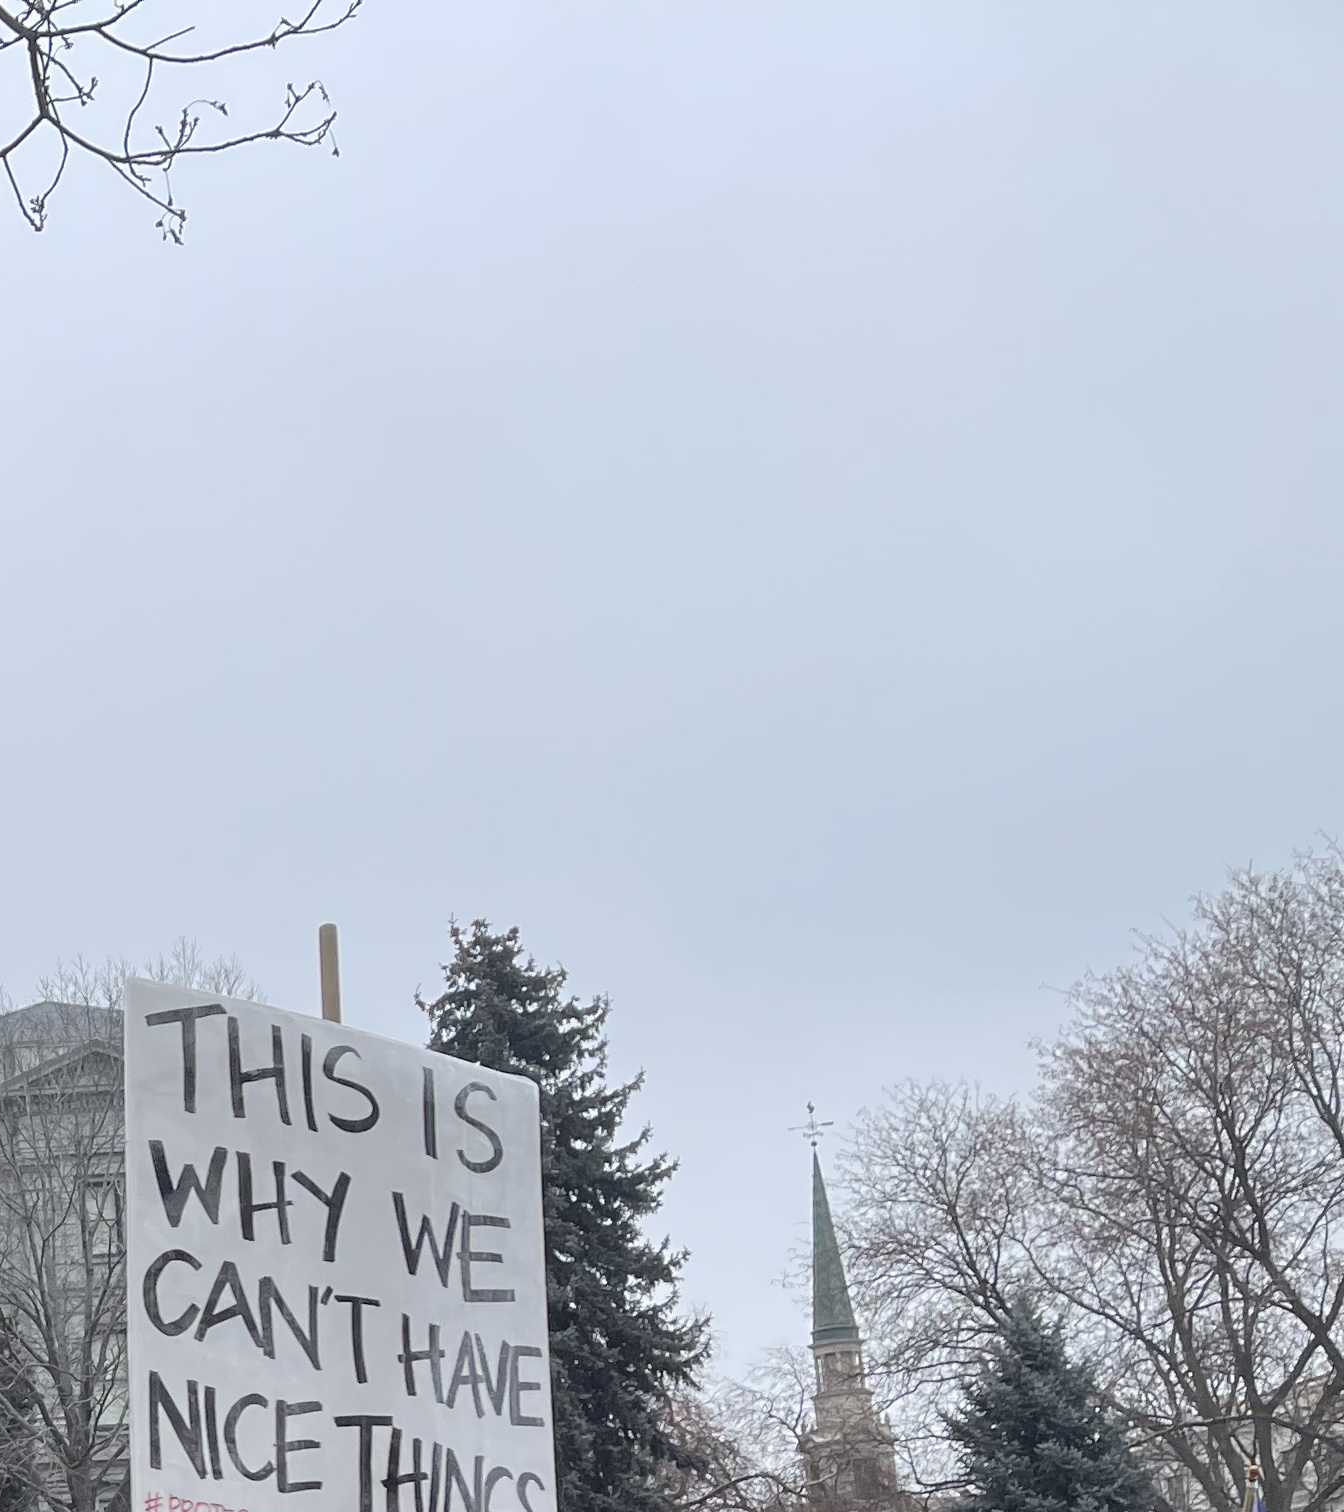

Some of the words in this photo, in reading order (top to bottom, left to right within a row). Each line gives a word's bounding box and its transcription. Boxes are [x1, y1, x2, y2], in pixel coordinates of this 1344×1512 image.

[144, 1002, 380, 1133] THIS
[422, 1066, 503, 1173] IS
[148, 1138, 352, 1262] WHY
[392, 1191, 516, 1302] WE
[143, 1248, 381, 1384] CAN'T
[398, 1313, 545, 1427] HAVE
[148, 1370, 323, 1493] NICE
